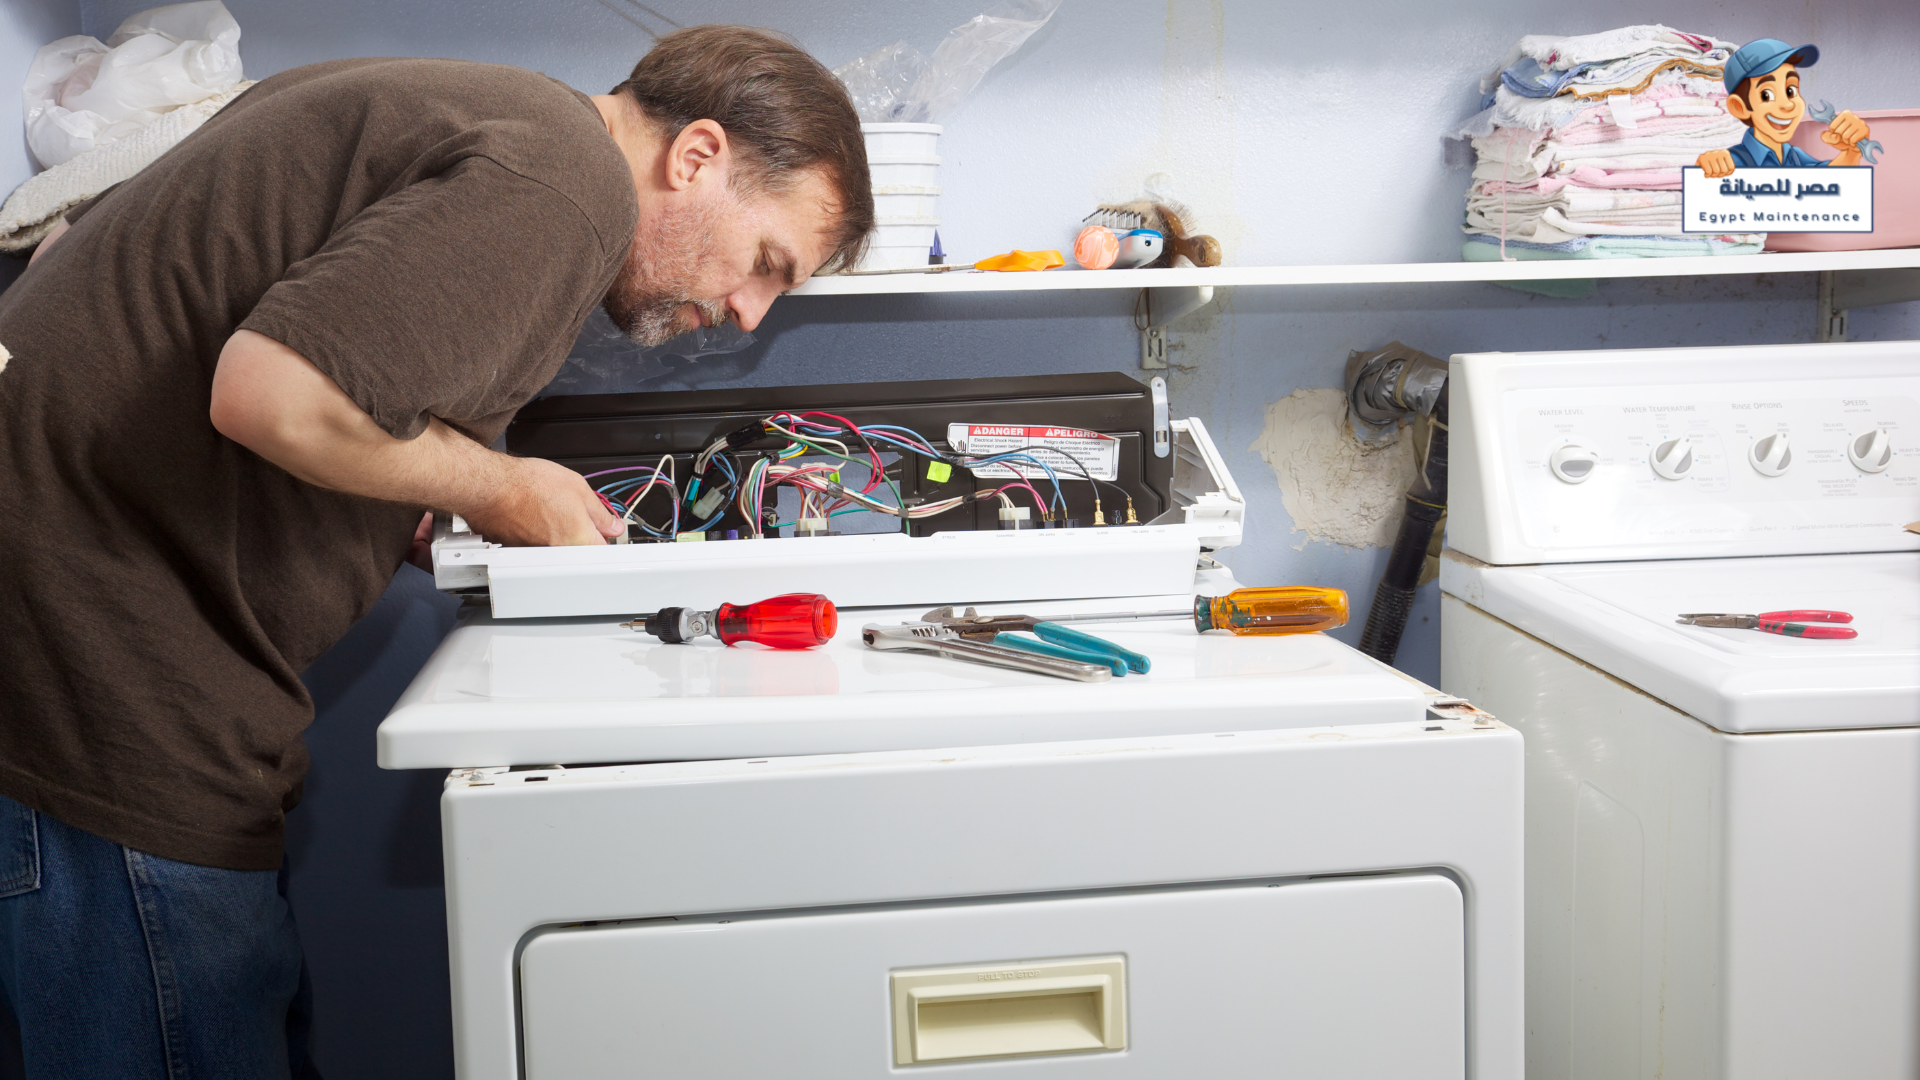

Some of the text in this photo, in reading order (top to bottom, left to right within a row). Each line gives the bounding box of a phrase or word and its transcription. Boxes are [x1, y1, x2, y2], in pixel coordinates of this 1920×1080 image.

[982, 427, 1024, 435] DANGER
[1054, 429, 1098, 438] PELIGRO
[977, 970, 1041, 981] PULL TO STOP
